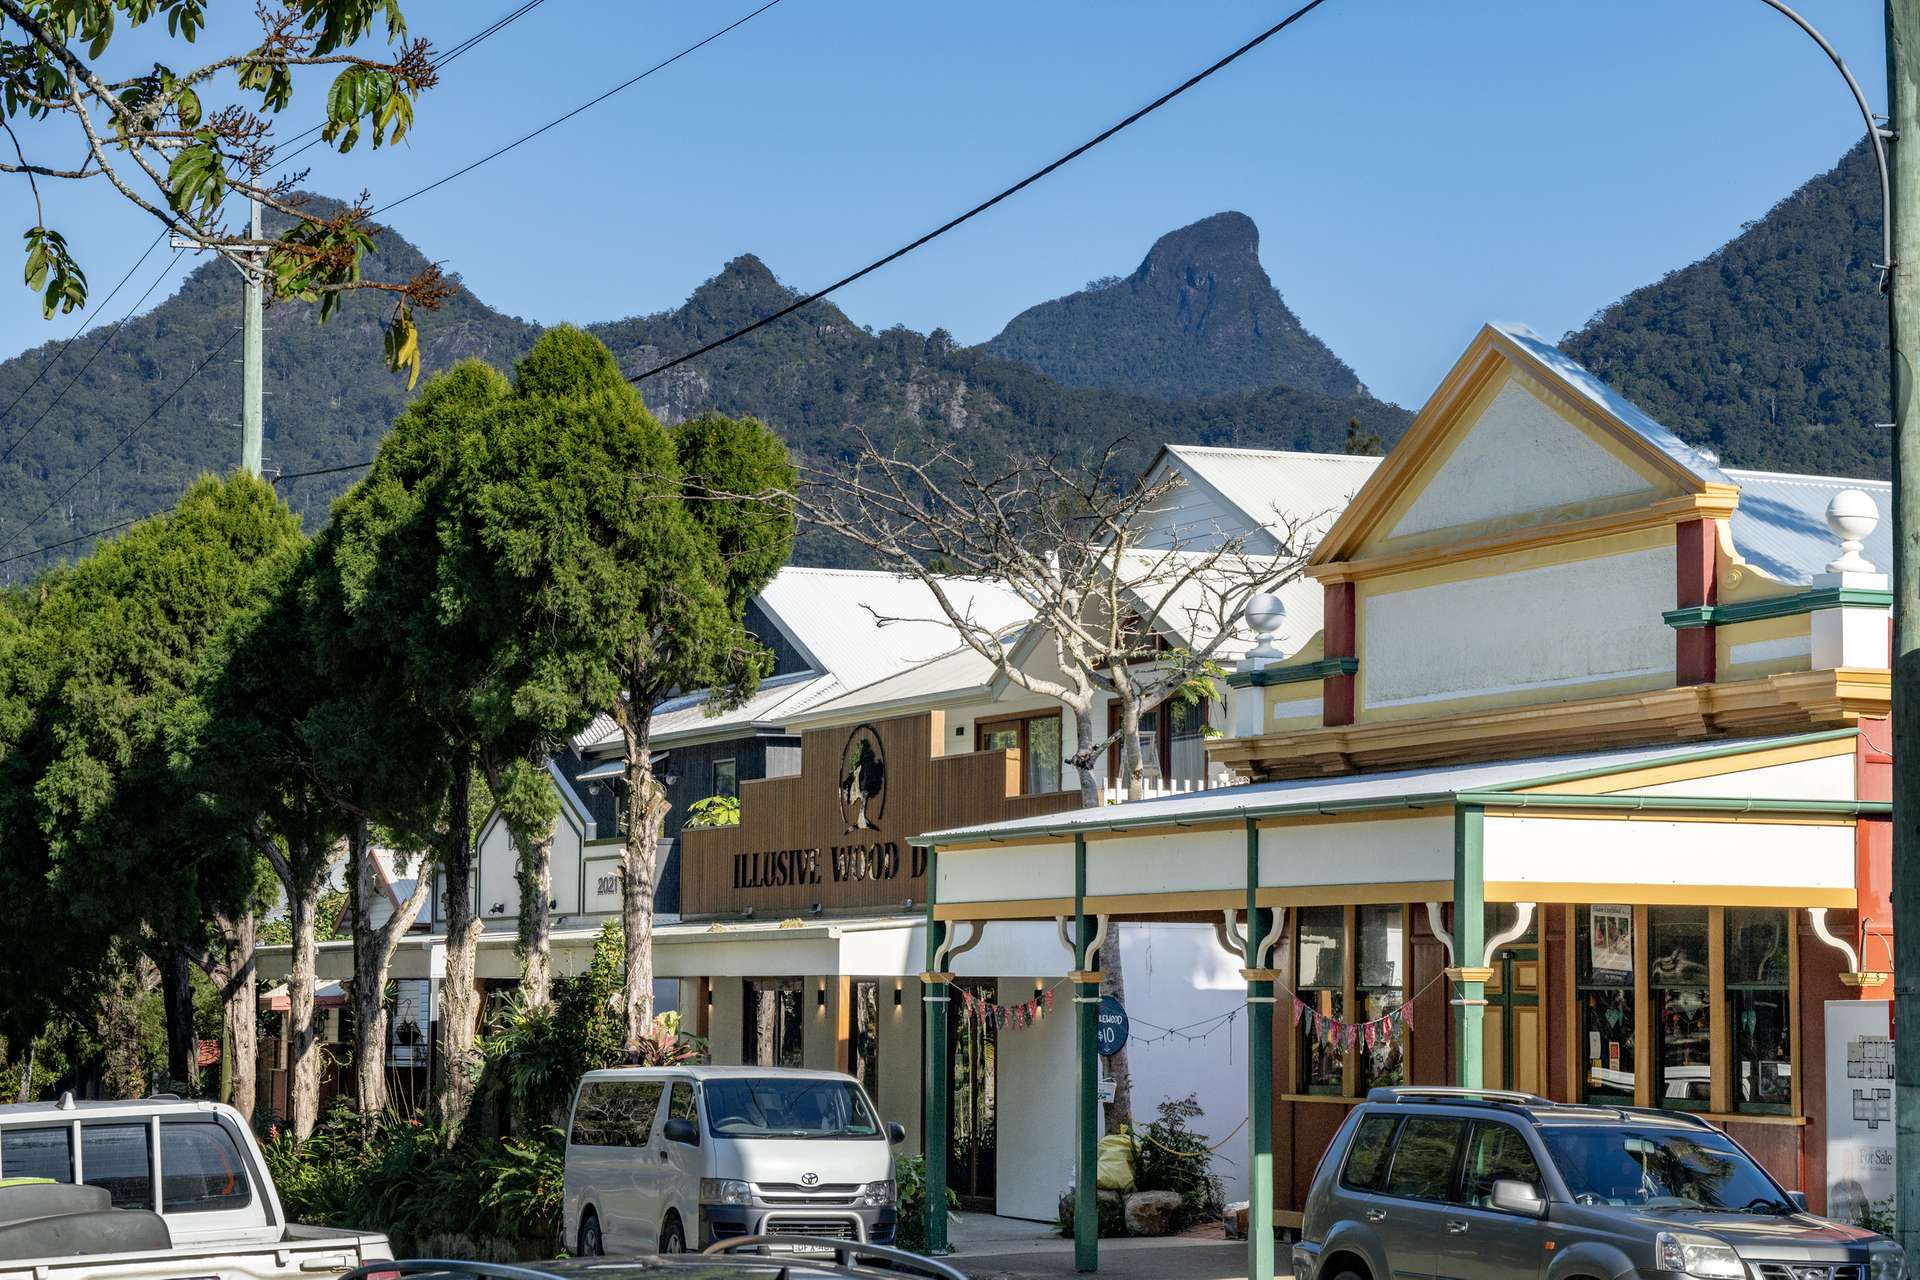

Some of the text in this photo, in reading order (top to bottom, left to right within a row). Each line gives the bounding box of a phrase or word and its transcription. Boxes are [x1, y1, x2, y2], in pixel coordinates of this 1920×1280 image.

[733, 848, 822, 889] ILLUSIVE
[831, 842, 899, 882] WOOD
[598, 877, 618, 896] 2021
[1098, 1027, 1116, 1044] $10
[1873, 1149, 1892, 1164] Sale
